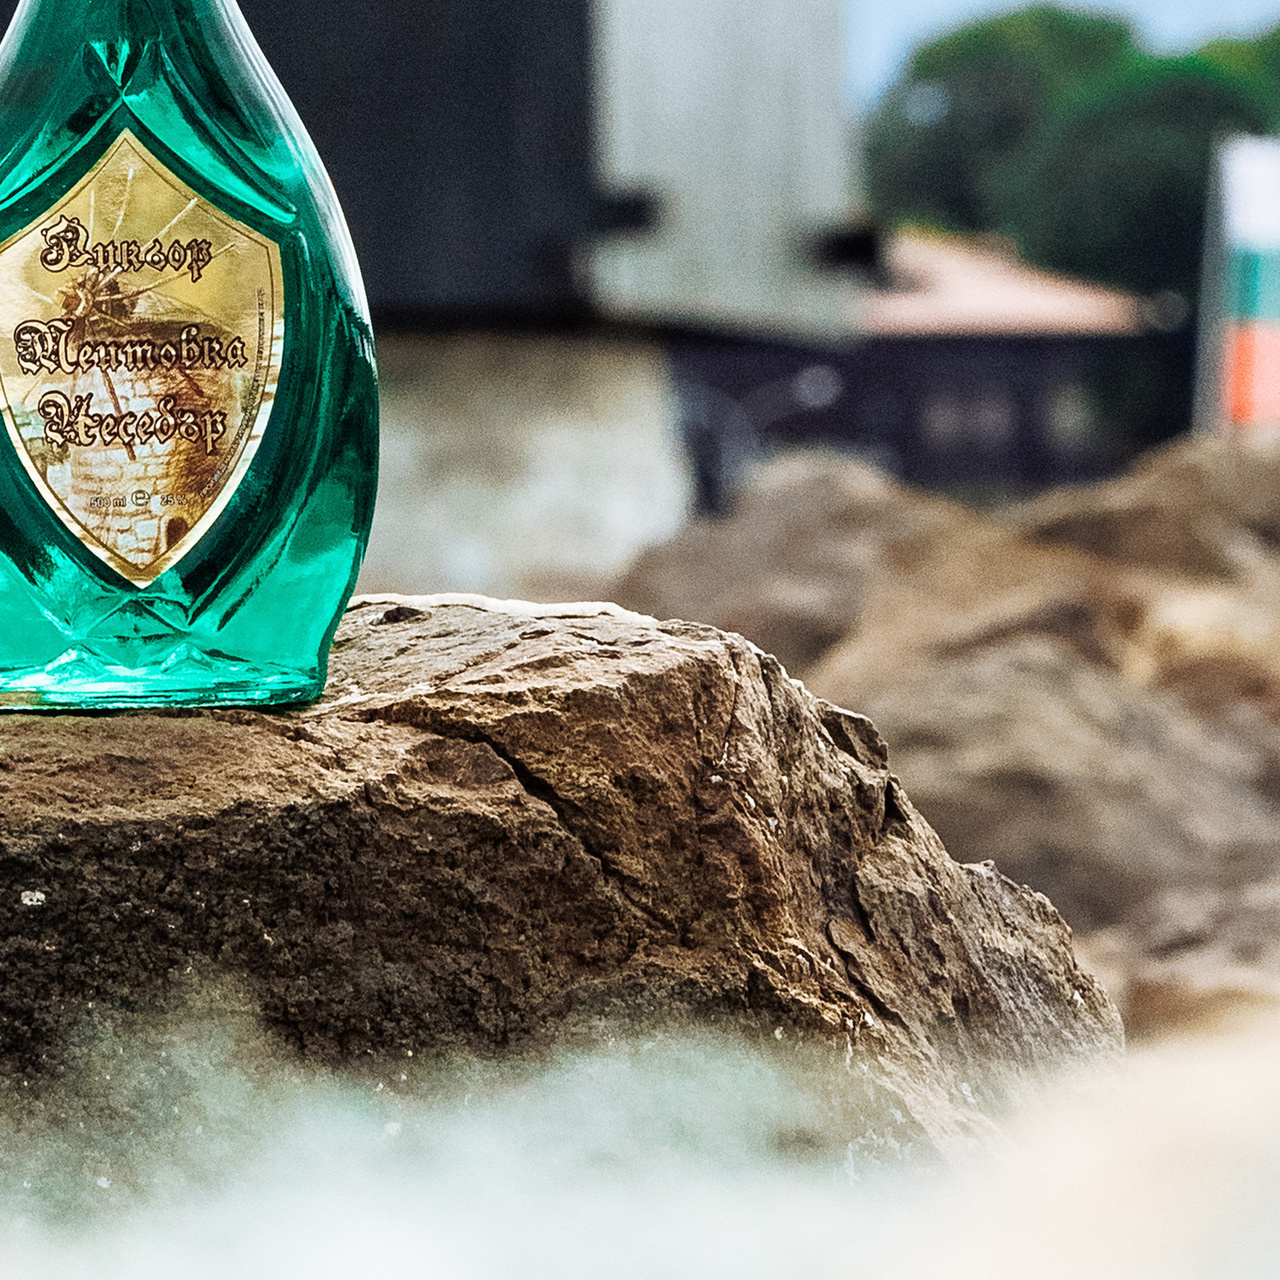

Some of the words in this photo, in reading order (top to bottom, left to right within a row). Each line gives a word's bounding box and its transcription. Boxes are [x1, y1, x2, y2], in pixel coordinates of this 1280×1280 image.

[13, 318, 249, 375] Ментовка
[37, 389, 228, 455] Несебър
[89, 495, 111, 508] 500
[113, 495, 127, 508] ml
